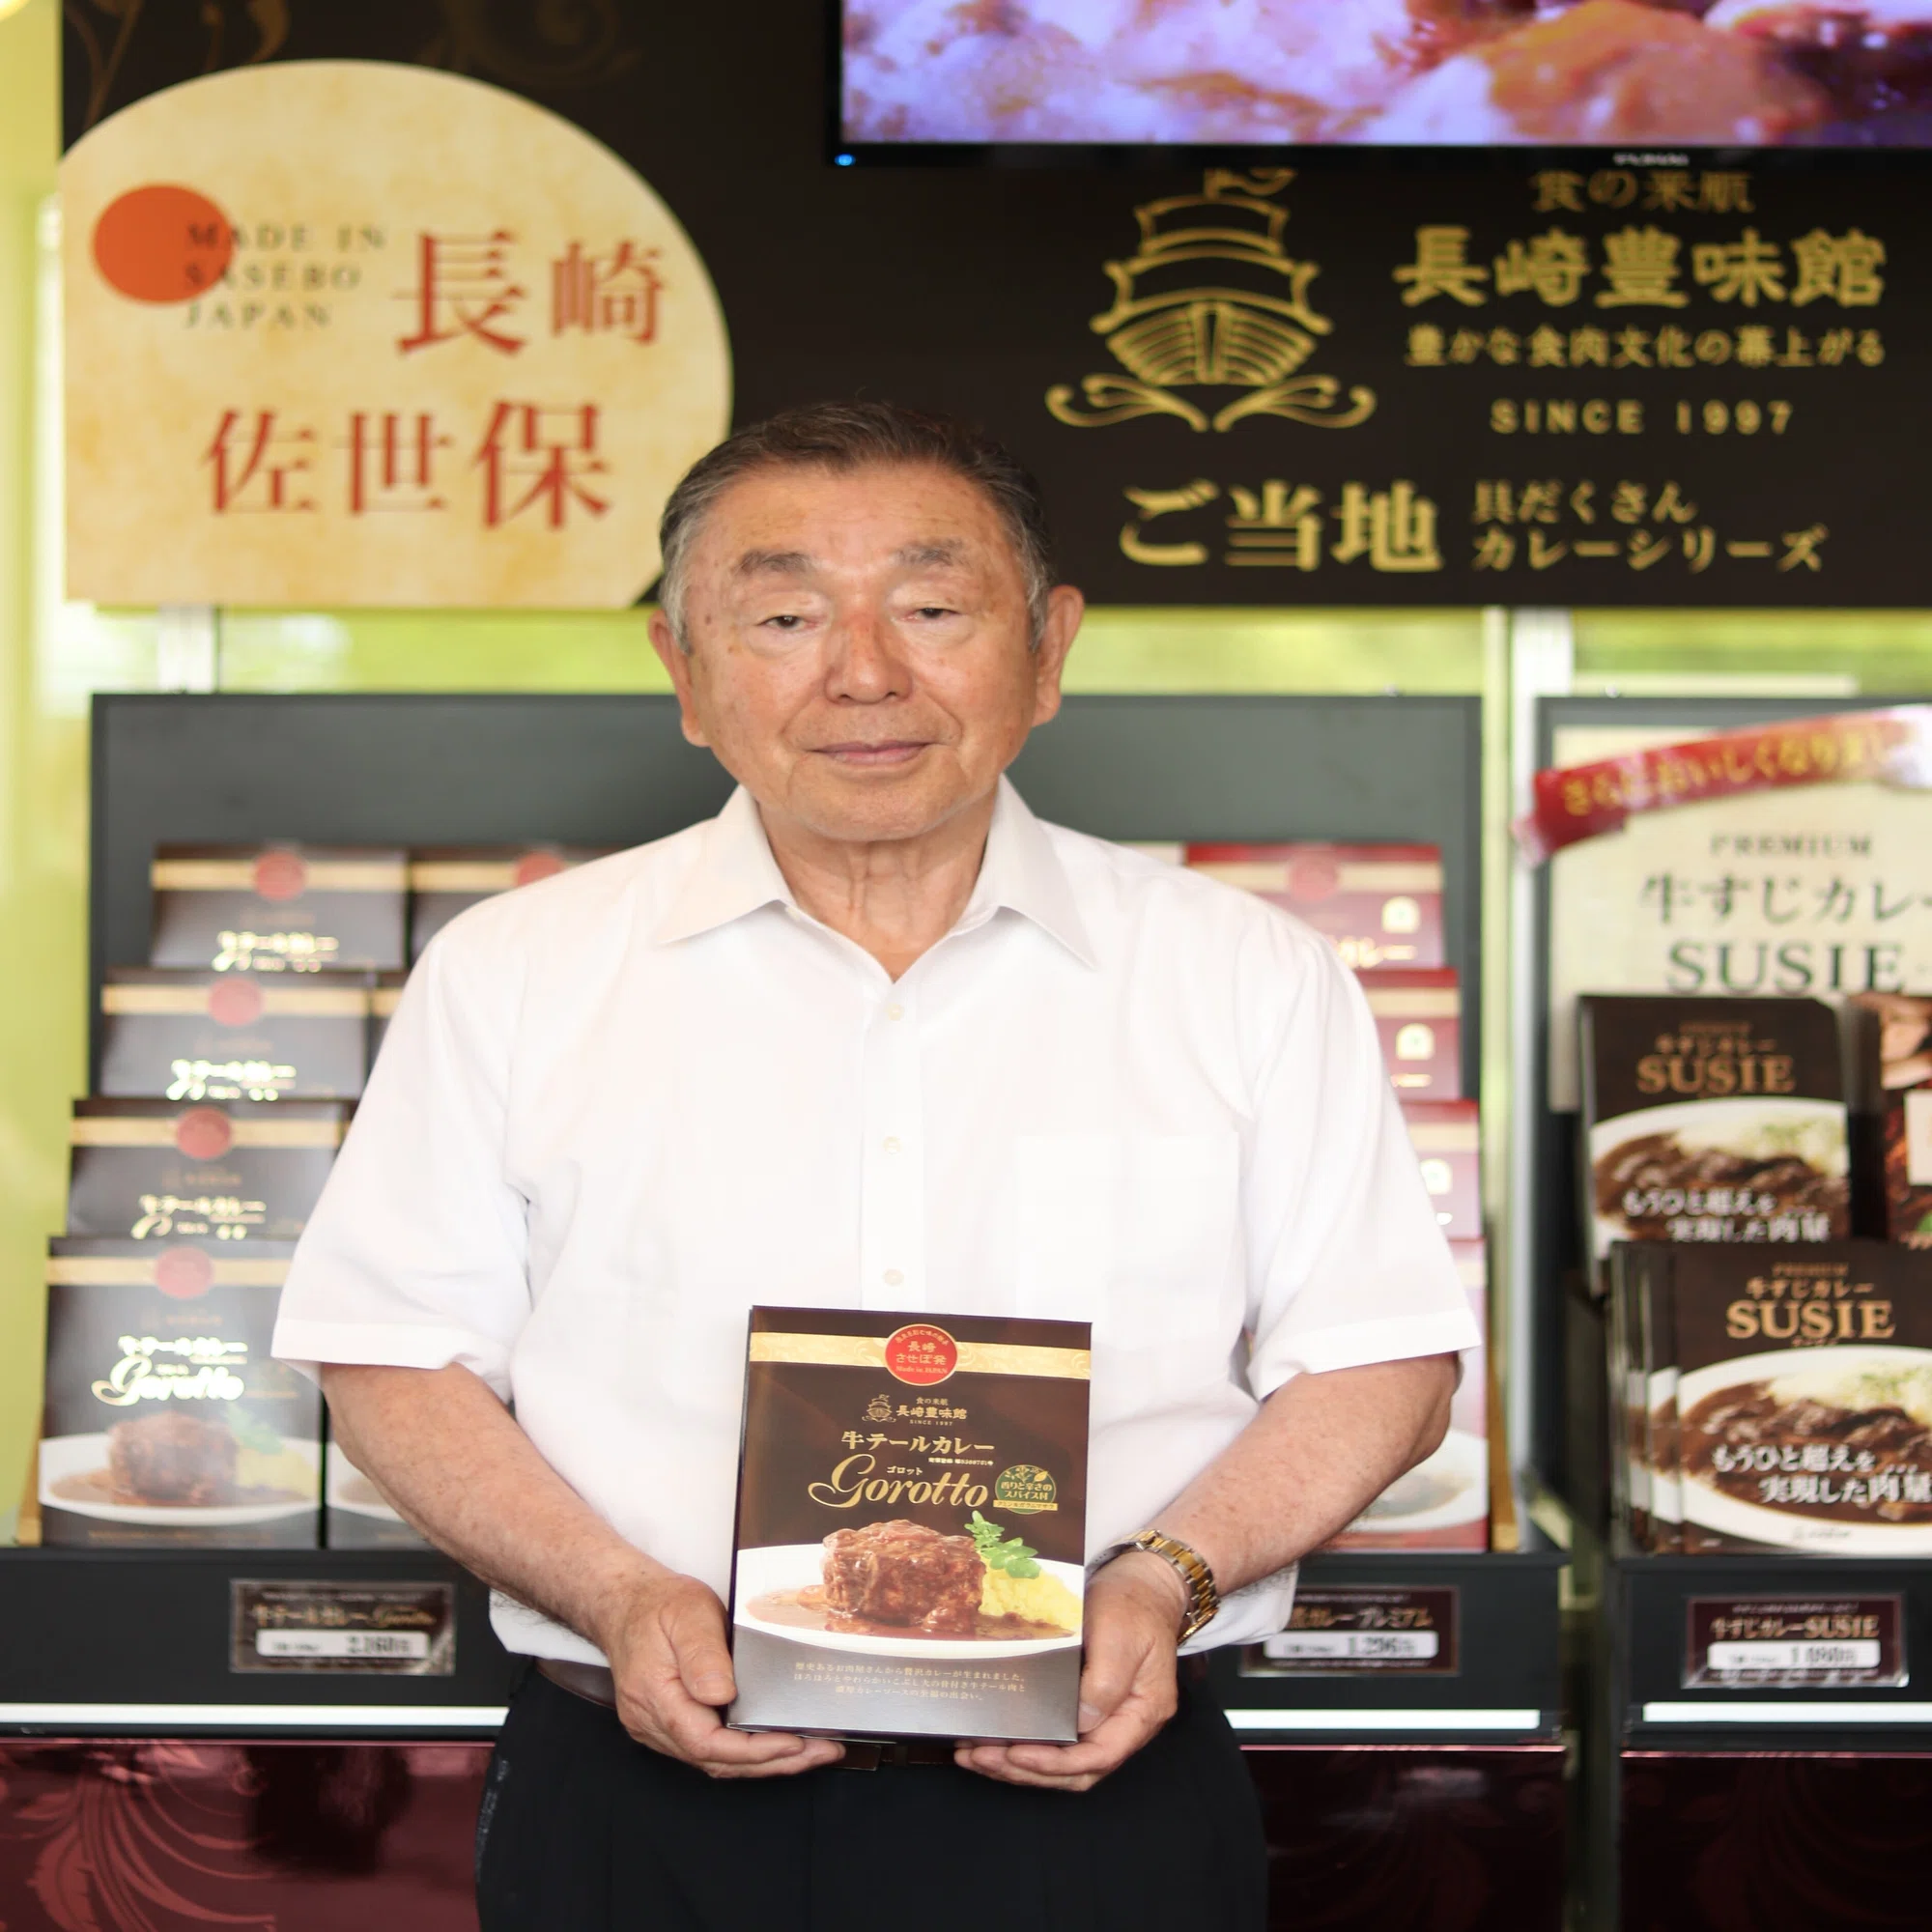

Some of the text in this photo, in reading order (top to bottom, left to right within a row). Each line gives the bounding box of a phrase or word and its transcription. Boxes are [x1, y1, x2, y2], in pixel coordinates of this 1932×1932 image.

[186, 221, 385, 253] MADE IN
[185, 262, 362, 292] SASEBO
[1392, 224, 1887, 308] 長崎豊味館
[393, 228, 665, 356] 長崎
[183, 301, 334, 330] JAPAN
[1490, 398, 1794, 435] SINCE 1997
[200, 399, 615, 532] 佐世保
[1470, 478, 1699, 525] 具だくさん
[1120, 479, 1445, 573] ご当地
[1470, 523, 1831, 575] カレーシリーズ
[1710, 833, 1873, 859] PREMIUM
[1665, 939, 1907, 994] SUSIE
[1636, 1055, 1796, 1094] SUSIE
[1725, 1298, 1896, 1339] SUSIE
[895, 1353, 948, 1366] させぼ発
[908, 1340, 936, 1353] 長崎
[895, 1405, 967, 1420] 長崎豊味館
[840, 1431, 996, 1456] 牛テールカレー
[807, 1453, 989, 1509] Gorotto
[886, 1464, 923, 1476] ゴロット
[1001, 1481, 1053, 1492] 香りと辛さの
[1005, 1491, 1049, 1501] スパイス付
